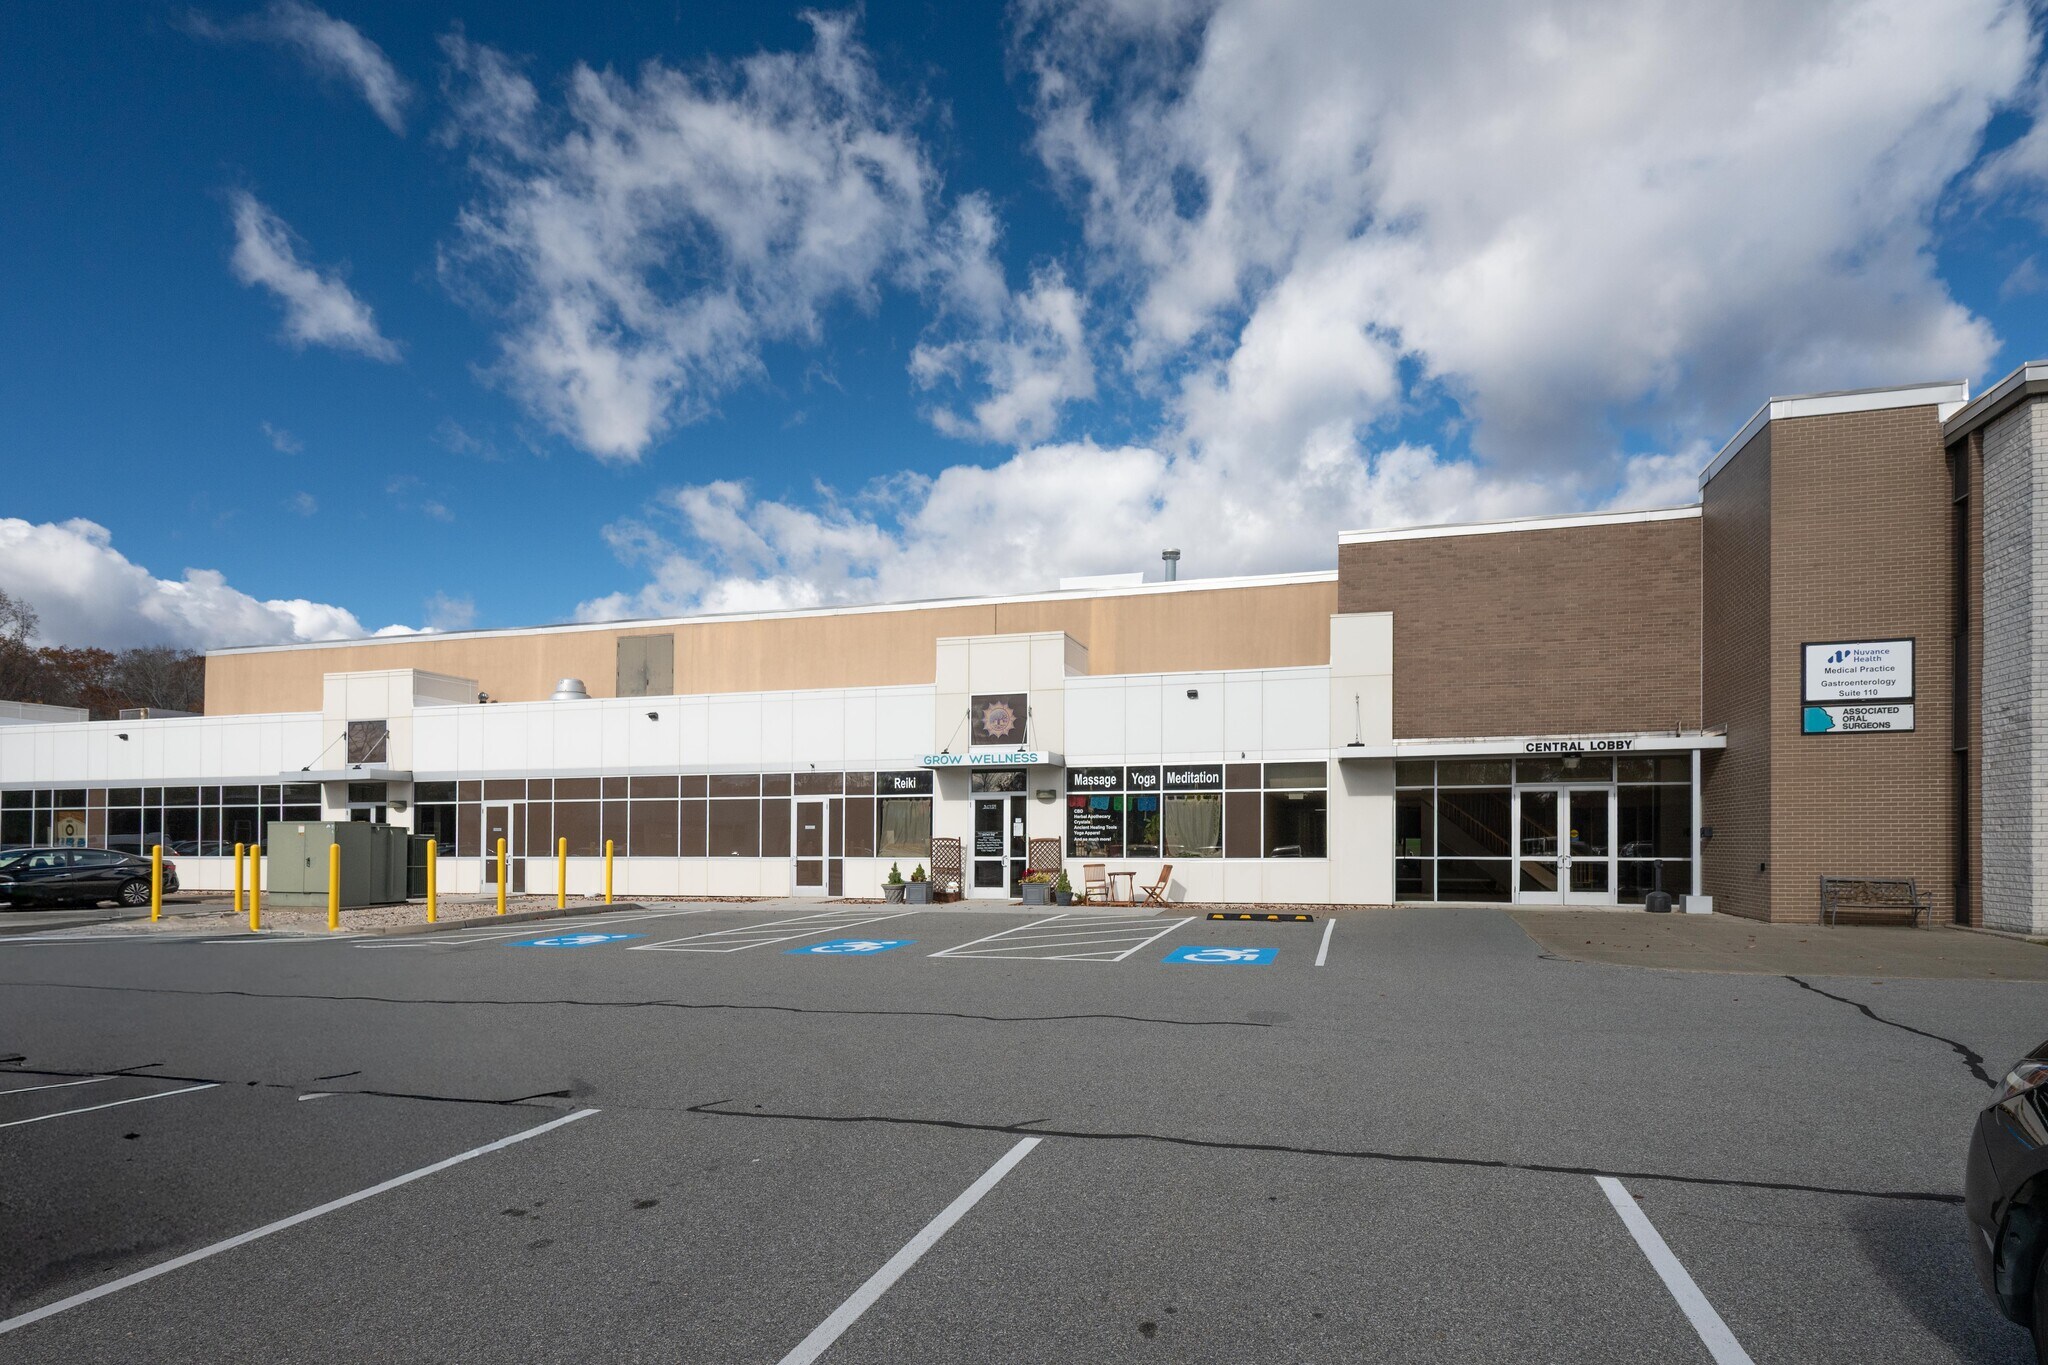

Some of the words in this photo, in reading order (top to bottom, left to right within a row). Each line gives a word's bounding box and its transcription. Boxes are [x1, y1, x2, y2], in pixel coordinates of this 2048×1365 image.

[1821, 678, 1896, 687] Gastroenterology
[1526, 742, 1585, 752] CENTRAL
[1590, 740, 1633, 750] LOBBY
[924, 755, 962, 765] GROW
[969, 753, 1038, 764] WELLNESS
[894, 777, 916, 789] Reiki
[1074, 773, 1117, 788] Massage
[1132, 772, 1156, 787] Yoga
[1167, 772, 1219, 784] Meditation
